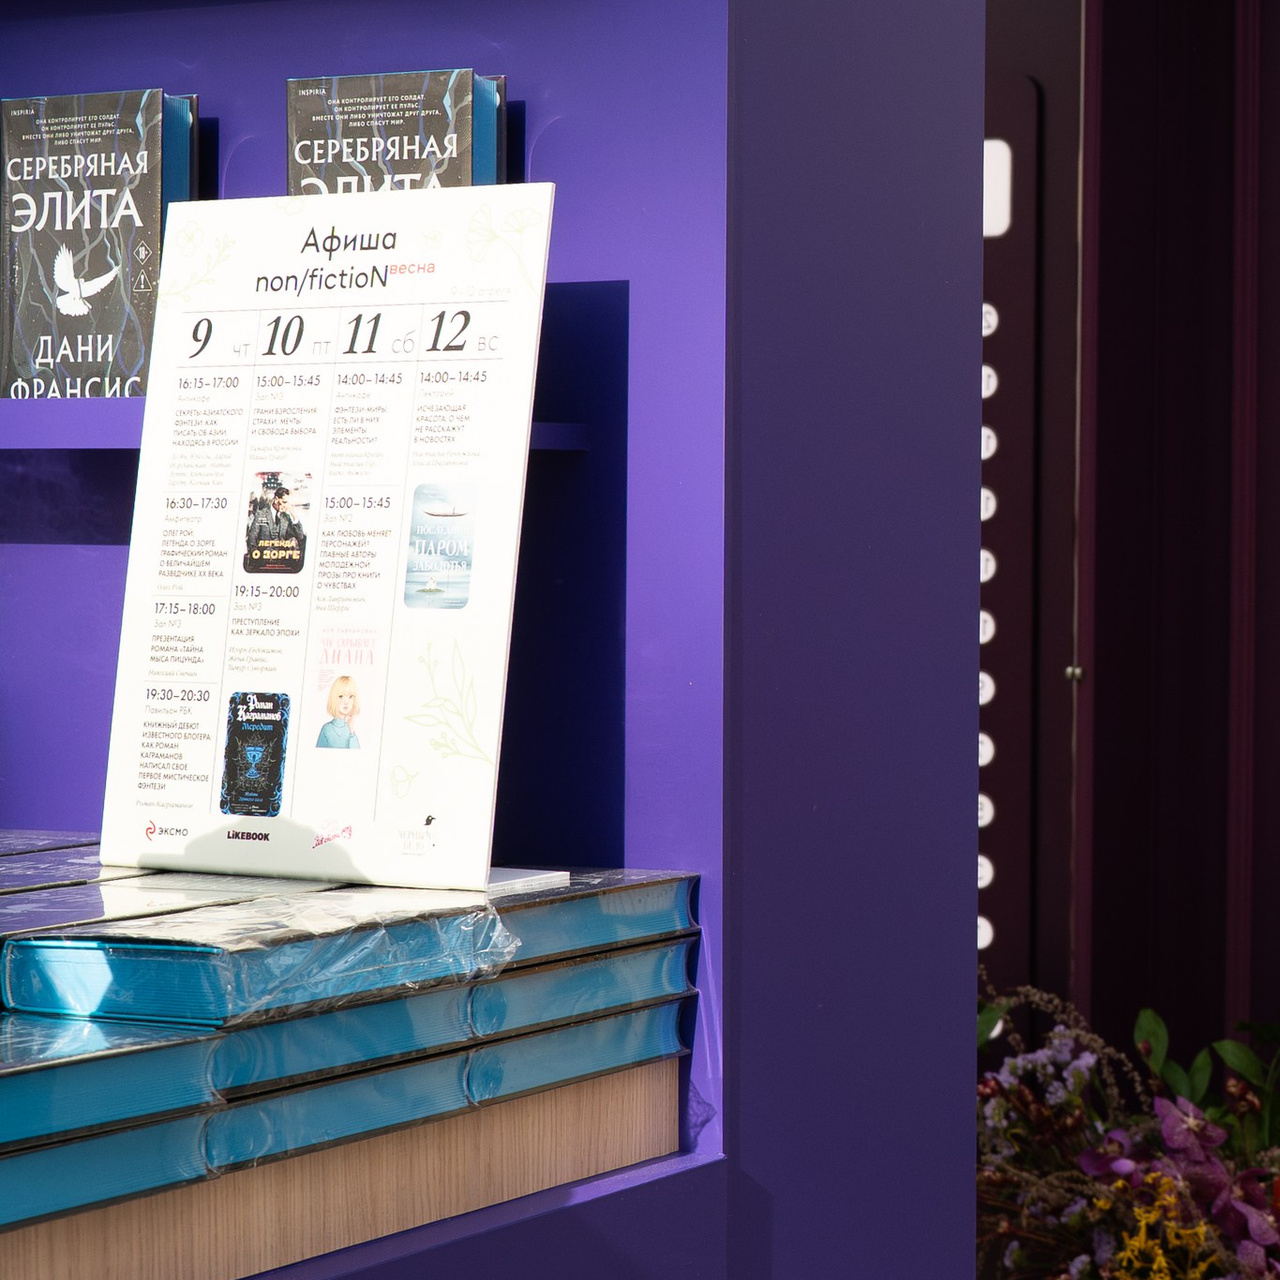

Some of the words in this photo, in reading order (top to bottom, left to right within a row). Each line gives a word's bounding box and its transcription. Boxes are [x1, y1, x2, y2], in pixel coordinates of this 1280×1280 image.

[298, 88, 326, 96] INSPIRIA
[341, 96, 387, 104] КОНТРОЛИРУЕТ
[294, 133, 457, 165] СЕРЕБРЯНАЯ
[6, 151, 149, 181] СЕРЕБРЯНАЯ
[11, 188, 144, 233] ЭЛИТА
[300, 225, 397, 261] Афиша
[256, 265, 389, 297] non/fictioN
[389, 262, 436, 275] весна
[189, 318, 213, 359] 9
[262, 315, 304, 356] 10
[343, 313, 382, 355] 11
[426, 310, 471, 352] 12
[35, 334, 113, 369] ДАНИ
[10, 377, 141, 399] ФРАНСИС
[257, 428, 289, 436] СВОБОДА
[161, 539, 189, 547] ЛЕГЕНДА
[415, 539, 469, 557] ПАРОМ
[252, 550, 260, 559] О
[263, 550, 300, 559] ЗОРГЕ
[319, 550, 350, 558] ГЛАВНЫЕ
[351, 550, 377, 558] АВТОРЫ
[231, 618, 280, 626] ПРЕСТУПЛЕНИЕ
[245, 629, 275, 637] ЗЕРКАЛО
[276, 629, 300, 637] ЭПОХИ
[151, 635, 195, 643] ПРЕЗЕНТАЦИЯ
[178, 722, 199, 730] ДЕБЮТ
[142, 731, 182, 739] ИЗВЕСТНОГО
[140, 752, 183, 760] КАГРАМАНОВ
[138, 772, 162, 780] ПЕРВОЕ
[162, 773, 209, 781] МИСТИЧЕСКОЕ
[137, 782, 166, 790] ФЭНТЕЗИ
[158, 827, 189, 837] ЭКСМО
